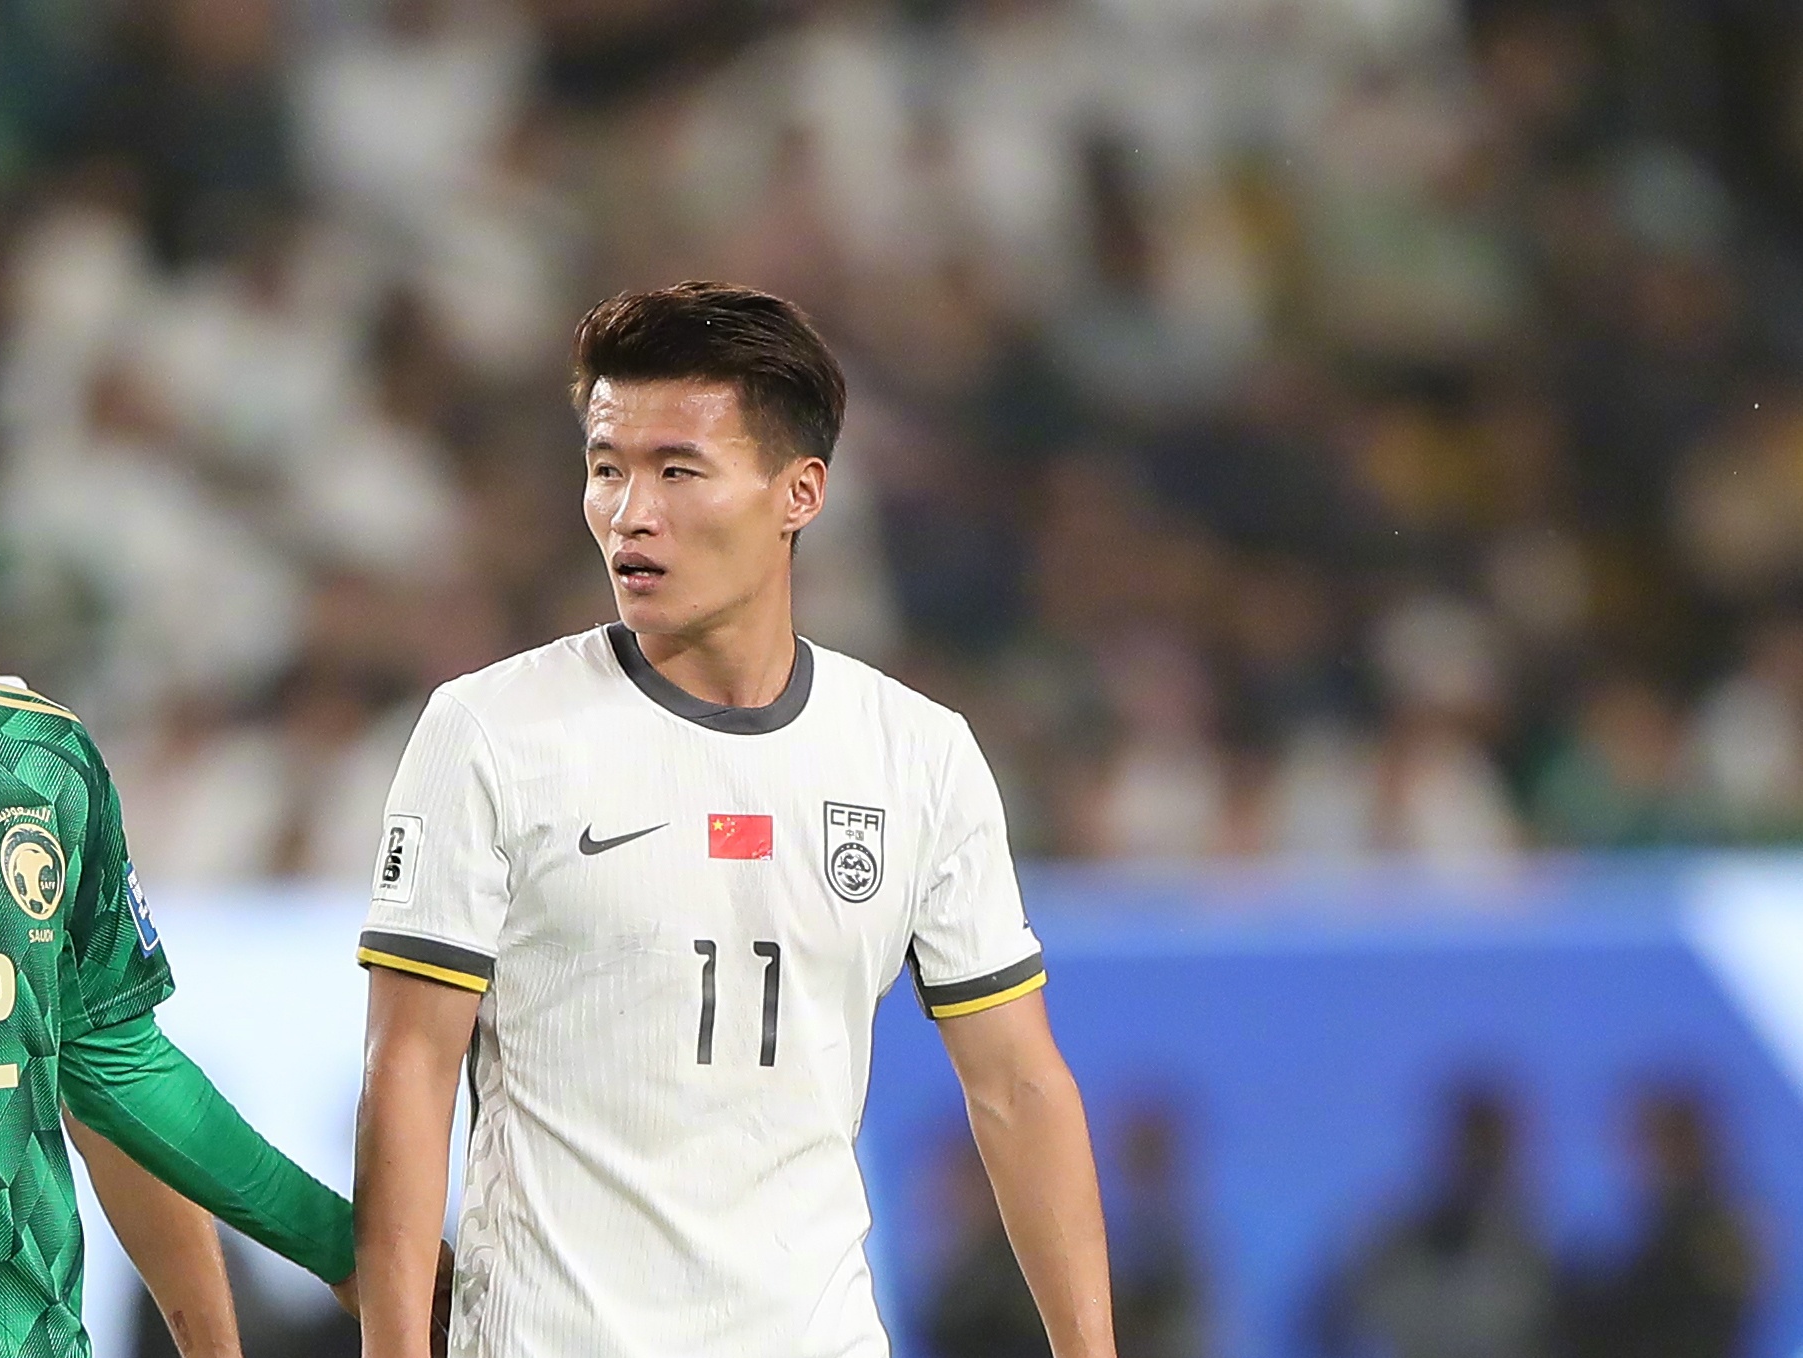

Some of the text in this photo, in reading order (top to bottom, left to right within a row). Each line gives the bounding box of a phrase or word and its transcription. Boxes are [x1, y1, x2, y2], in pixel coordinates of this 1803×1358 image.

[831, 808, 879, 831] CFA
[29, 929, 55, 943] SAUDI
[694, 939, 780, 1067] 11
